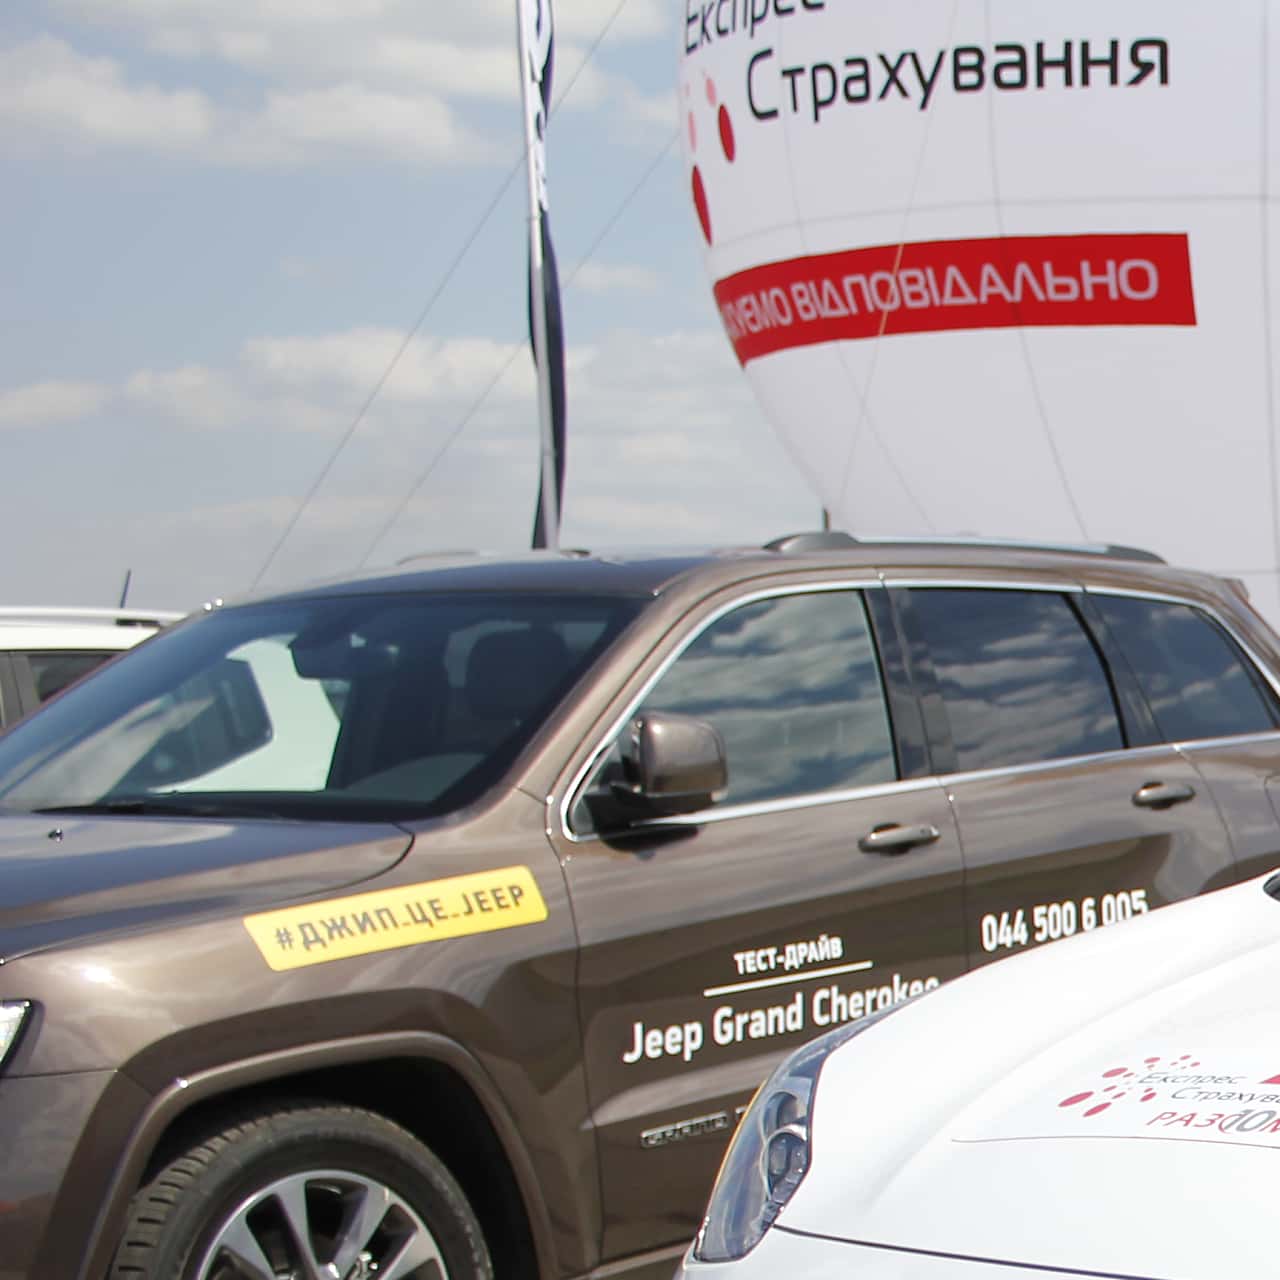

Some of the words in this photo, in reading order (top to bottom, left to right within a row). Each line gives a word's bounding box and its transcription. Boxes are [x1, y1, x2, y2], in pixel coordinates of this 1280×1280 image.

[747, 38, 1169, 122] Страхування
[790, 259, 1159, 321] ВІДПОВІДАЛЬНО
[982, 909, 1028, 951] 044
[1034, 901, 1076, 941] 500
[1082, 897, 1096, 931] 6
[1102, 890, 1149, 926] 005
[734, 934, 843, 974] ТЕСТ-ДРАЙВ
[623, 1022, 702, 1063] Jeep
[713, 992, 803, 1045] Grand
[1138, 1071, 1246, 1085] Експрес
